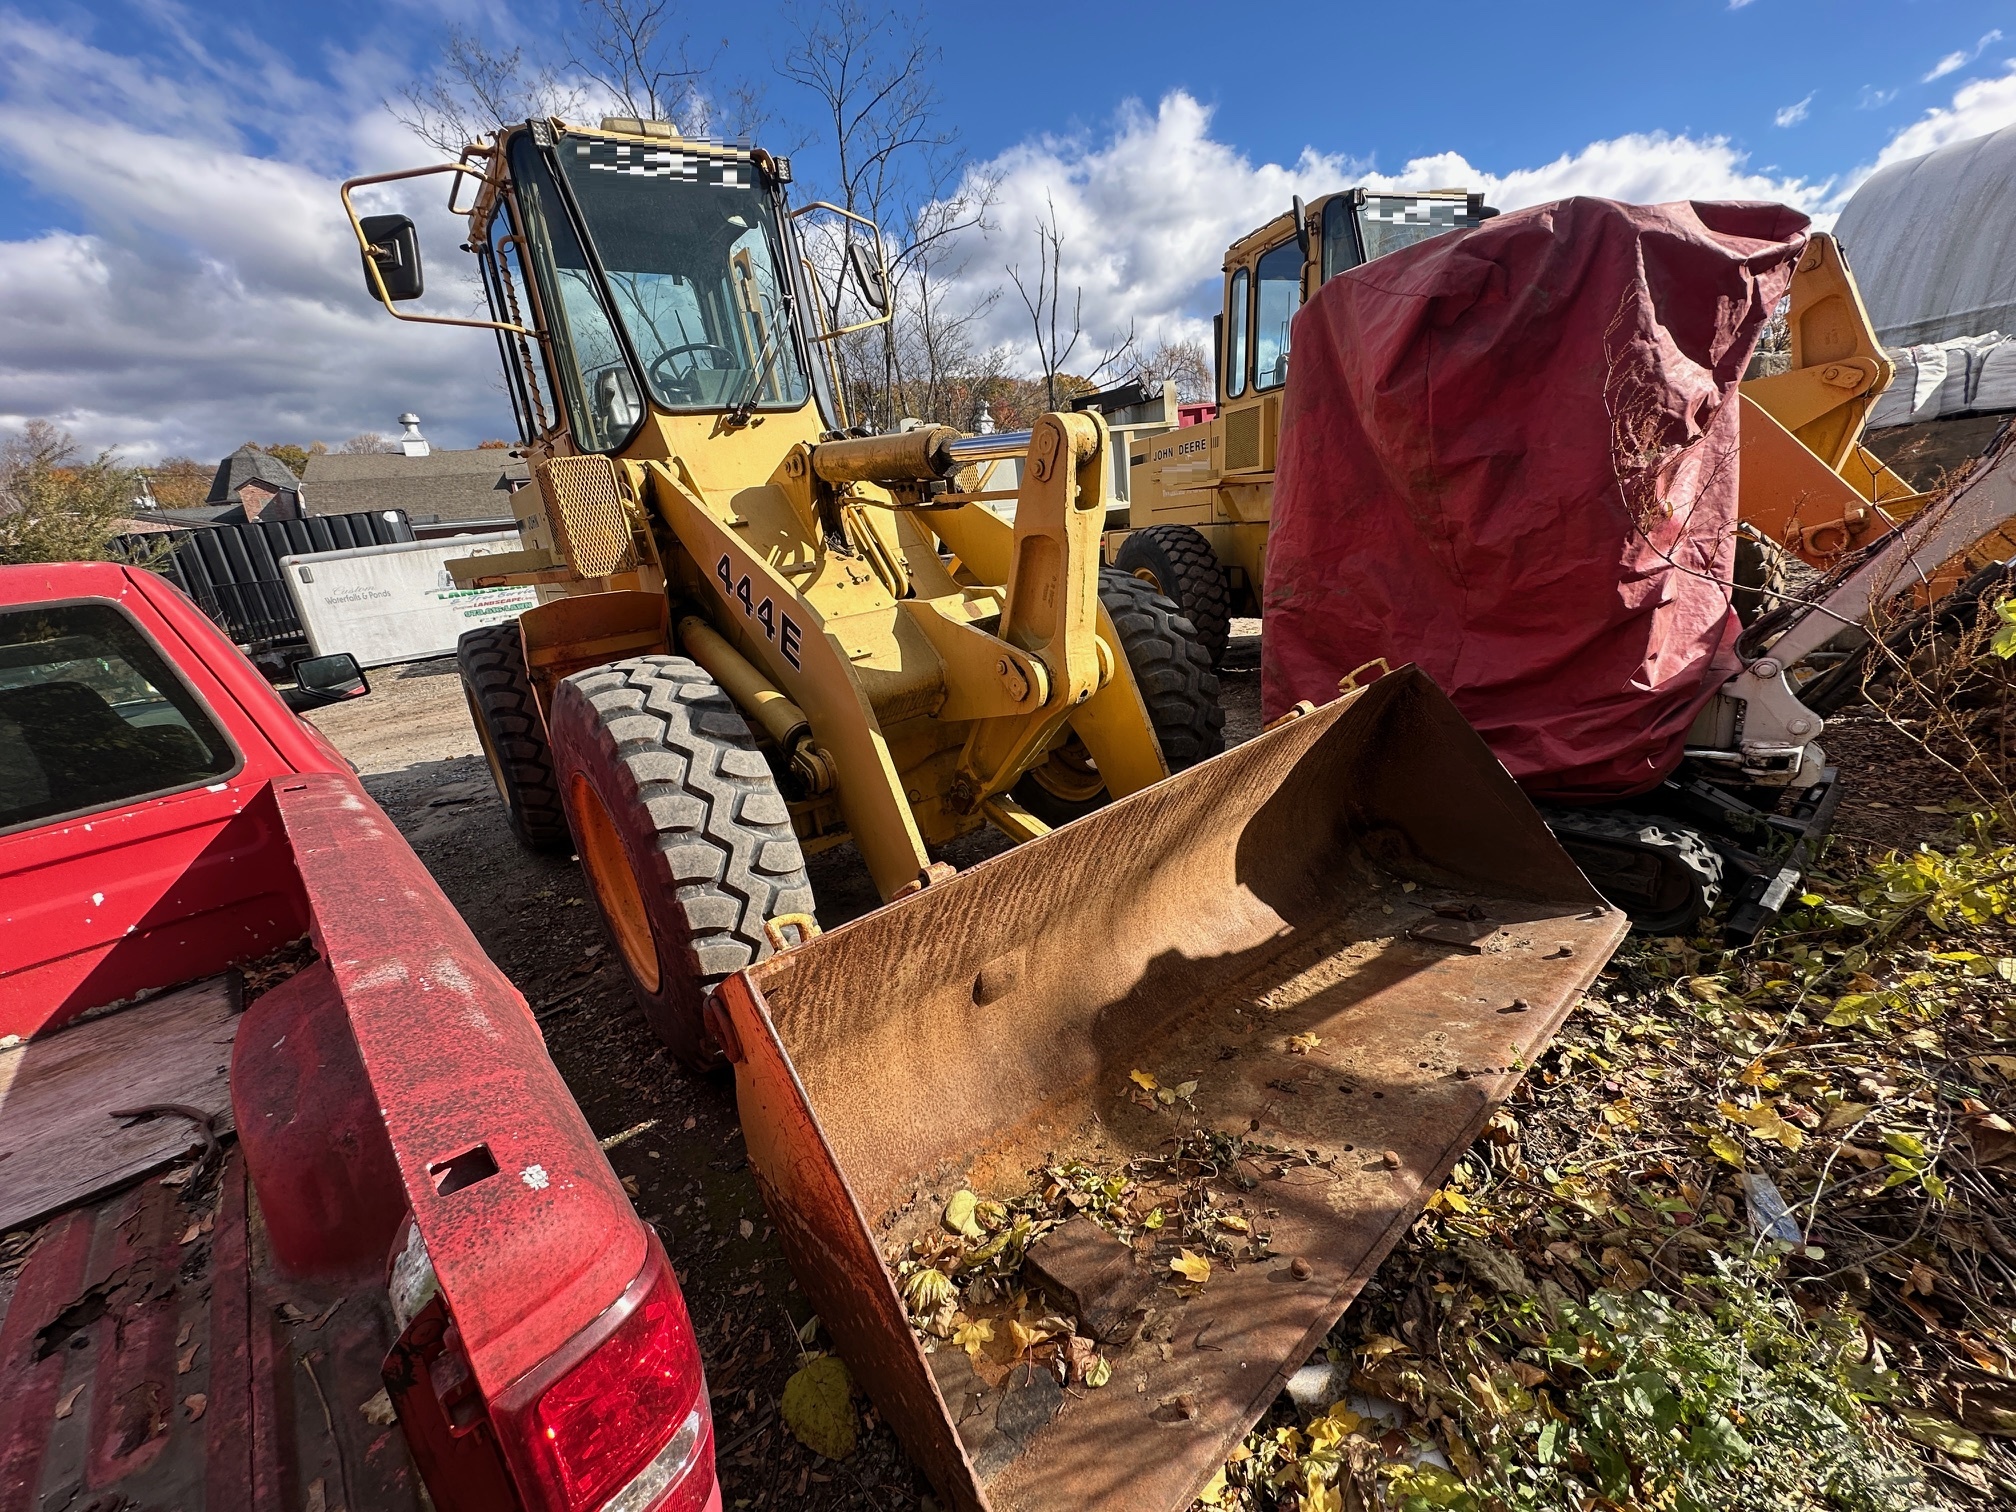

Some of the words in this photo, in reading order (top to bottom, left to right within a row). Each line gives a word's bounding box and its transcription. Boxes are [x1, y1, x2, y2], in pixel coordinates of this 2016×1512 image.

[1153, 447, 1173, 461] JOHN
[1178, 439, 1206, 455] DEERE
[324, 594, 361, 605] Waterfalls
[368, 589, 391, 599] Ponds
[473, 597, 522, 607] LANDSCAPE
[717, 552, 802, 673] 444E
